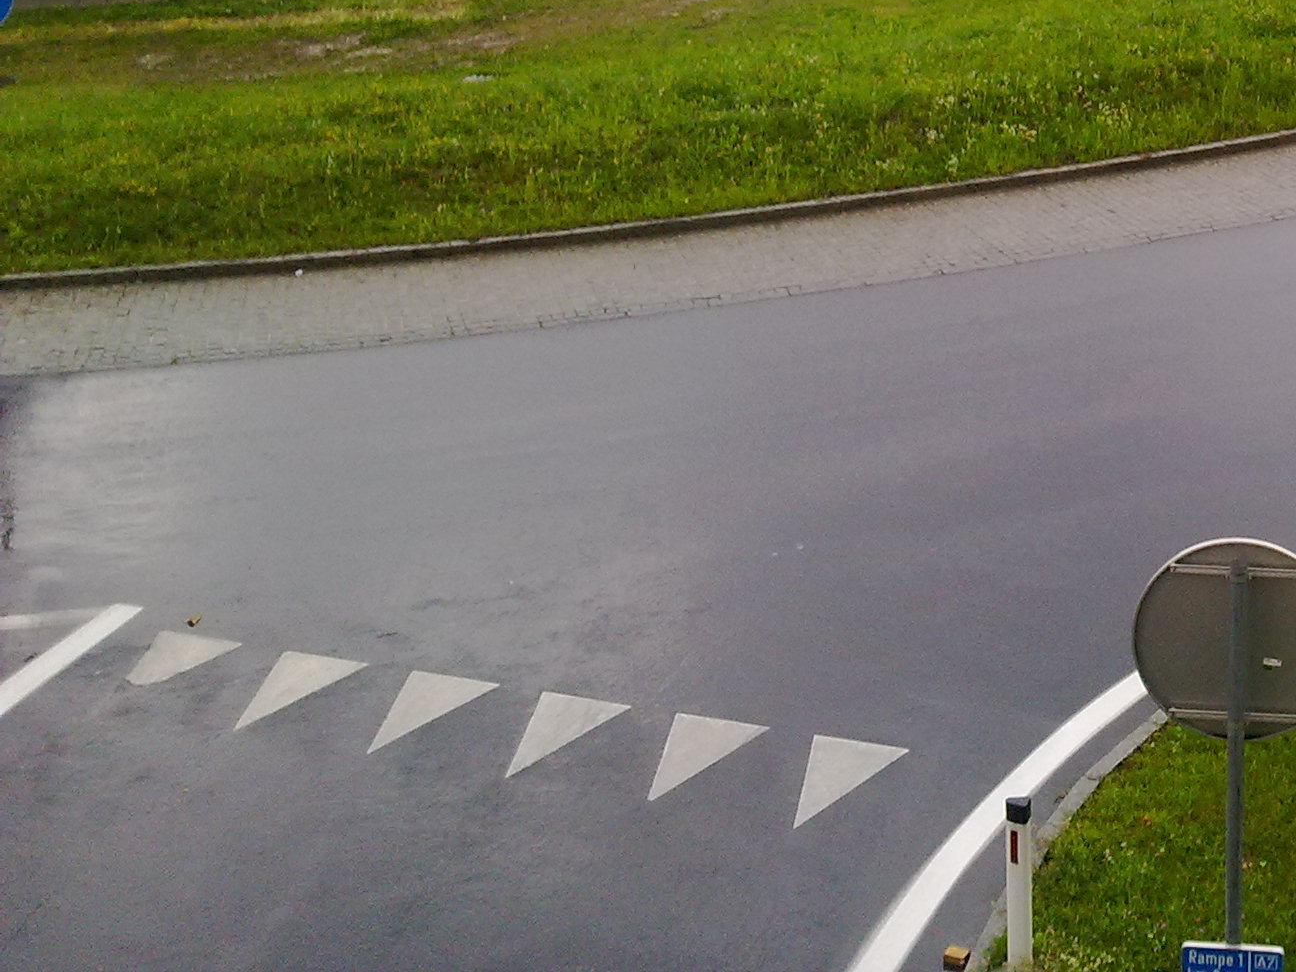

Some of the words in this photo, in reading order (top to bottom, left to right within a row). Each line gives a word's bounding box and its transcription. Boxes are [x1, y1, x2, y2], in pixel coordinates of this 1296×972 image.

[1189, 949, 1234, 970] Rampe
[1238, 953, 1243, 968] 1
[1257, 955, 1276, 969] A7
